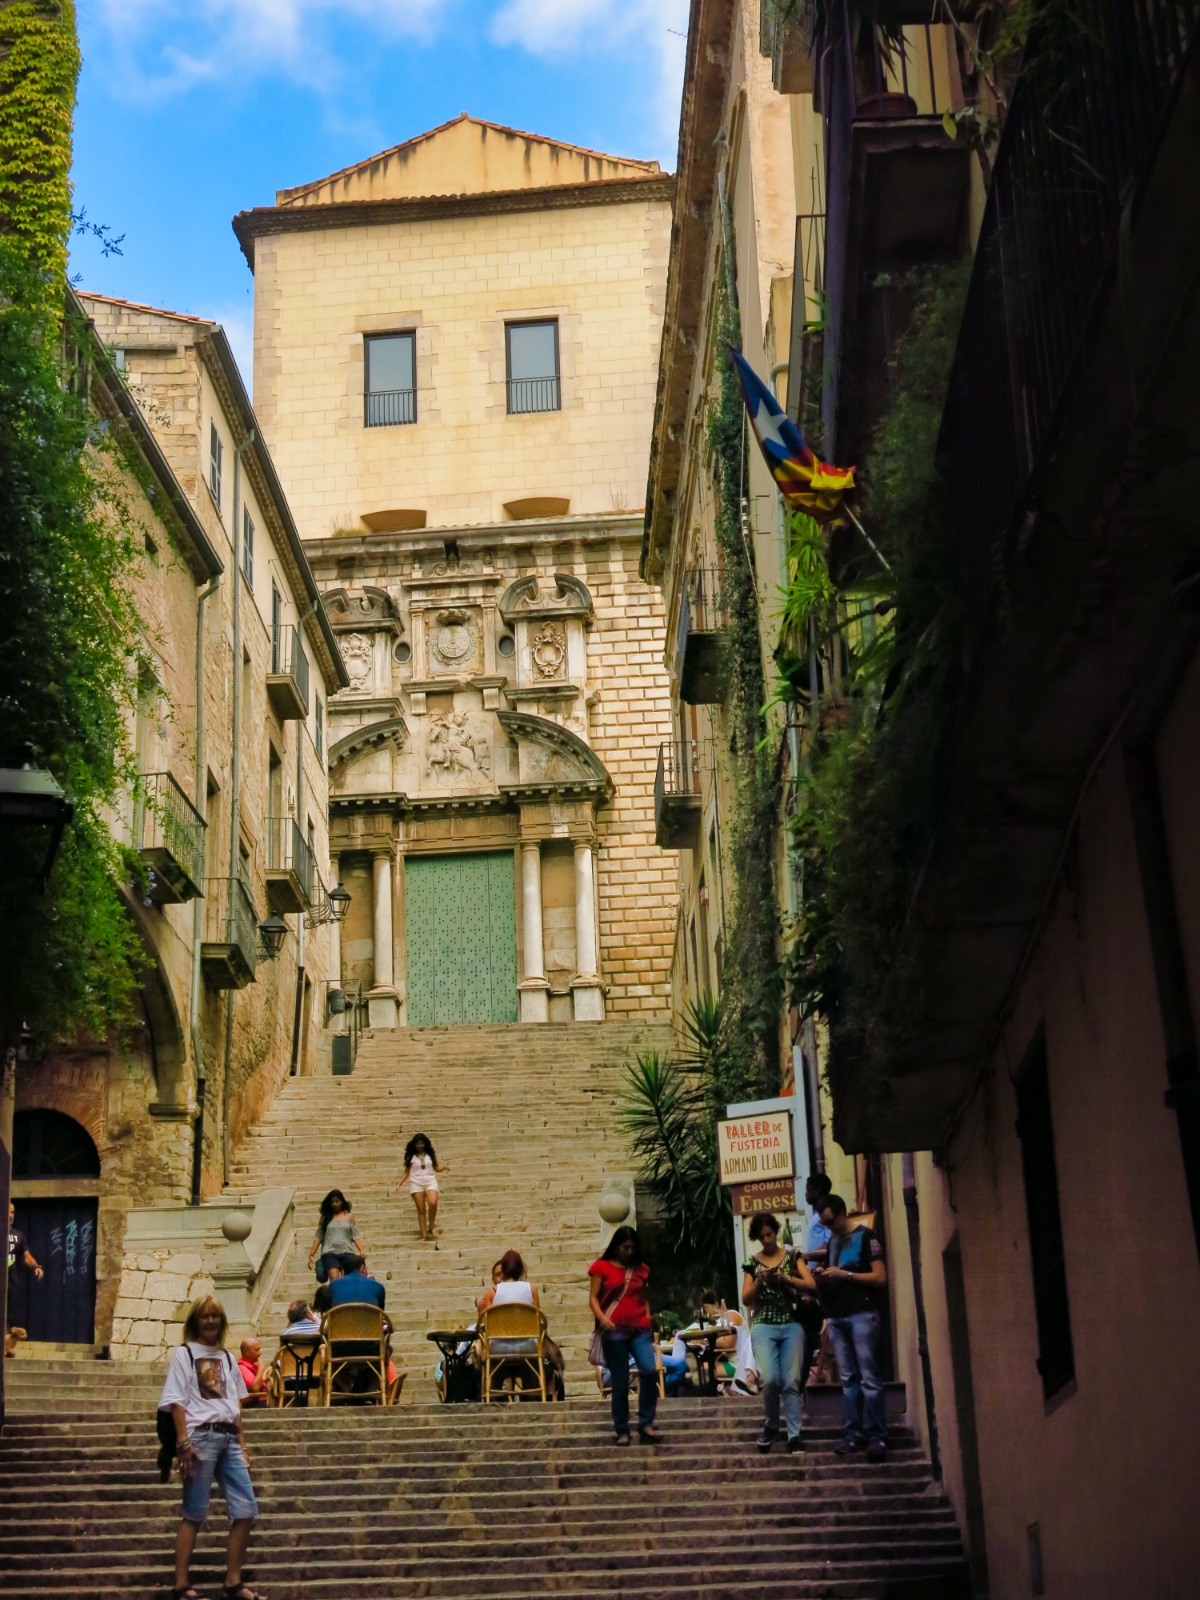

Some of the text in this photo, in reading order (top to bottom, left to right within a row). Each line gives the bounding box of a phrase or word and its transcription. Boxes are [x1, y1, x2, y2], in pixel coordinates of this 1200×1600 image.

[725, 1121, 783, 1139] TALLER DE
[730, 1137, 780, 1152] FUSTERIA
[724, 1152, 789, 1175] ARMAND LLADO
[744, 1180, 793, 1192] CROMATS
